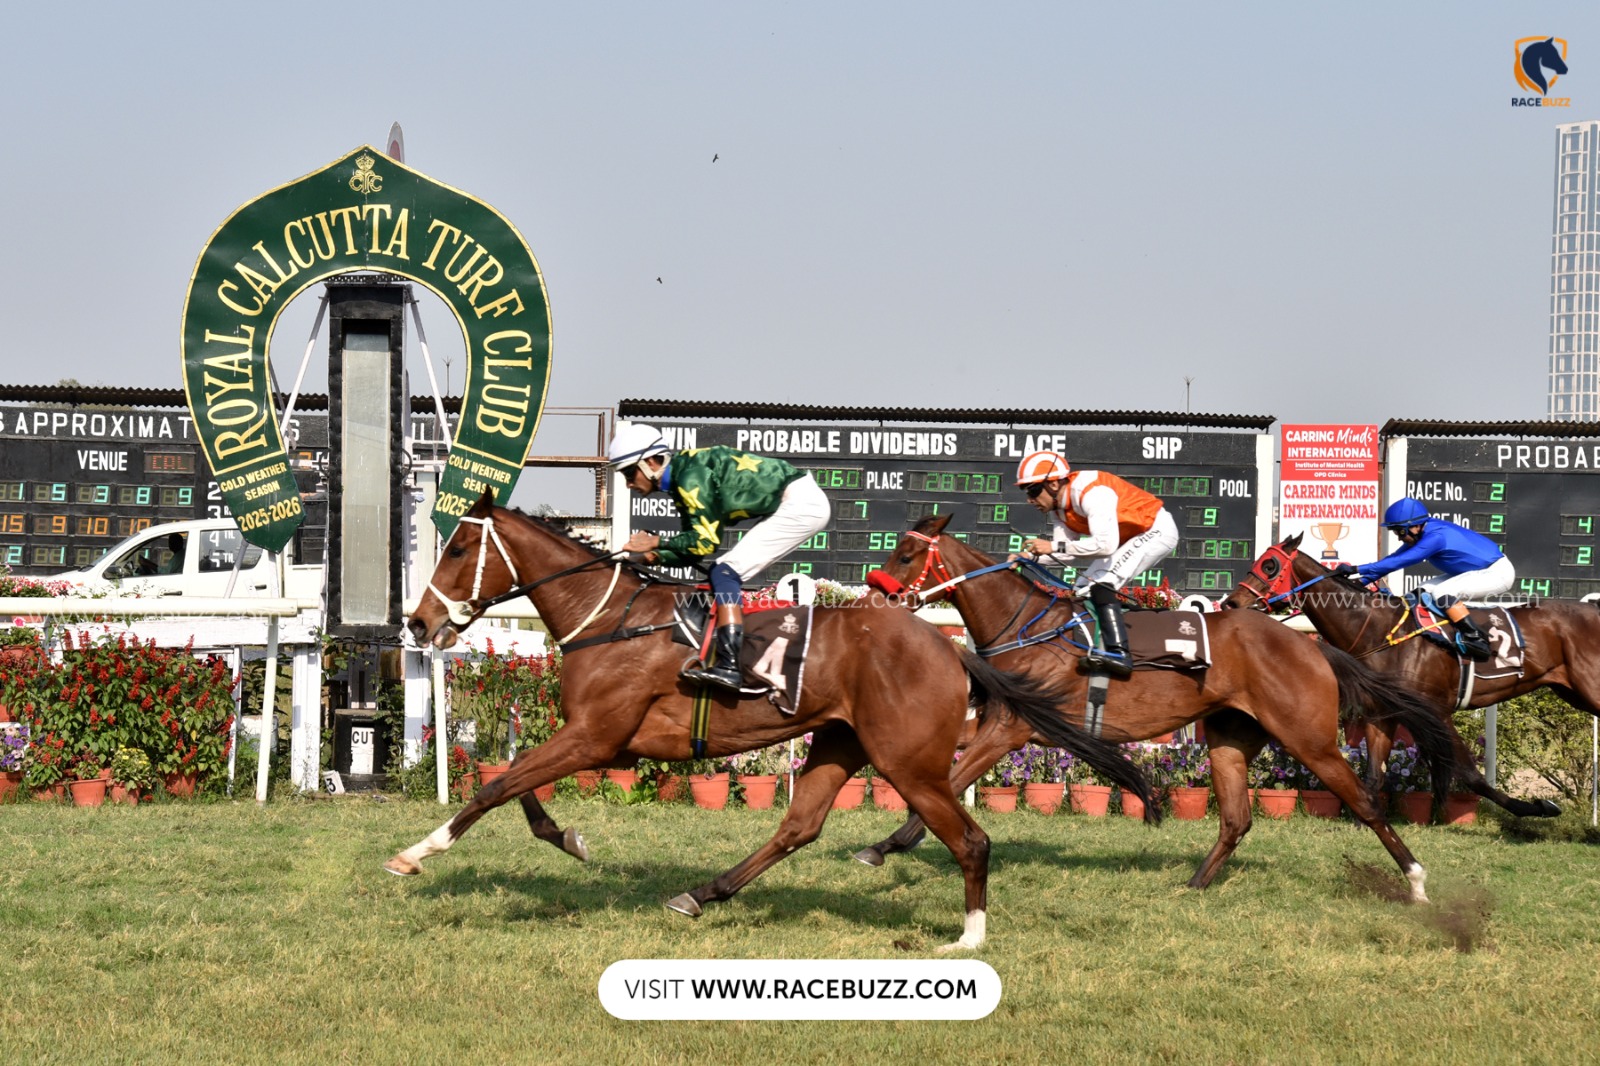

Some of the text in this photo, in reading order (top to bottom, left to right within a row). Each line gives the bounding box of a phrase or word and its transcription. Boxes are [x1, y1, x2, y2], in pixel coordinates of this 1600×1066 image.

[203, 204, 533, 460] ROYAL CALCUTTA TURF CLUB
[15, 412, 193, 438] APPROXIMAT
[661, 427, 697, 450] WIN
[736, 429, 958, 456] PROBABLE DIVIDENDS
[1285, 430, 1335, 443] CARRING
[1336, 426, 1373, 447] Minds
[994, 434, 1066, 459] PLACE
[1141, 437, 1183, 460] SHP
[1287, 447, 1374, 459] INTERNATIONAL
[77, 450, 128, 471] VENUE
[152, 455, 188, 470] CAL
[448, 453, 512, 484] COLD WEATHER
[220, 462, 288, 493] COLD WEATHER
[866, 471, 904, 490] PLACE
[51, 483, 67, 502] 5
[94, 485, 110, 503] 3
[136, 487, 151, 505] 8
[178, 487, 193, 506] 9
[244, 480, 281, 501] SEASON
[462, 476, 500, 499] SEASN
[1219, 478, 1252, 498] POOL
[1283, 484, 1376, 500] CARRING MINDS
[1407, 480, 1468, 502] RACE No.
[1490, 483, 1505, 501] 2
[237, 496, 302, 532] 2025-2026
[854, 501, 868, 519] 7
[993, 504, 1007, 522] 8
[1203, 508, 1217, 526] 9
[1282, 504, 1377, 519] INTERNATIONAL
[51, 515, 67, 534] 9
[86, 517, 109, 535] 10
[1489, 514, 1504, 533] 2
[1578, 516, 1592, 534] 4
[868, 532, 898, 550] 56
[1204, 539, 1250, 559] 387
[7, 545, 23, 564] 2
[1577, 546, 1592, 565] 2
[1203, 571, 1232, 589] 67
[1520, 578, 1550, 597] 44
[787, 578, 800, 605] 1
[1487, 626, 1521, 669] 2
[752, 636, 789, 690] 4
